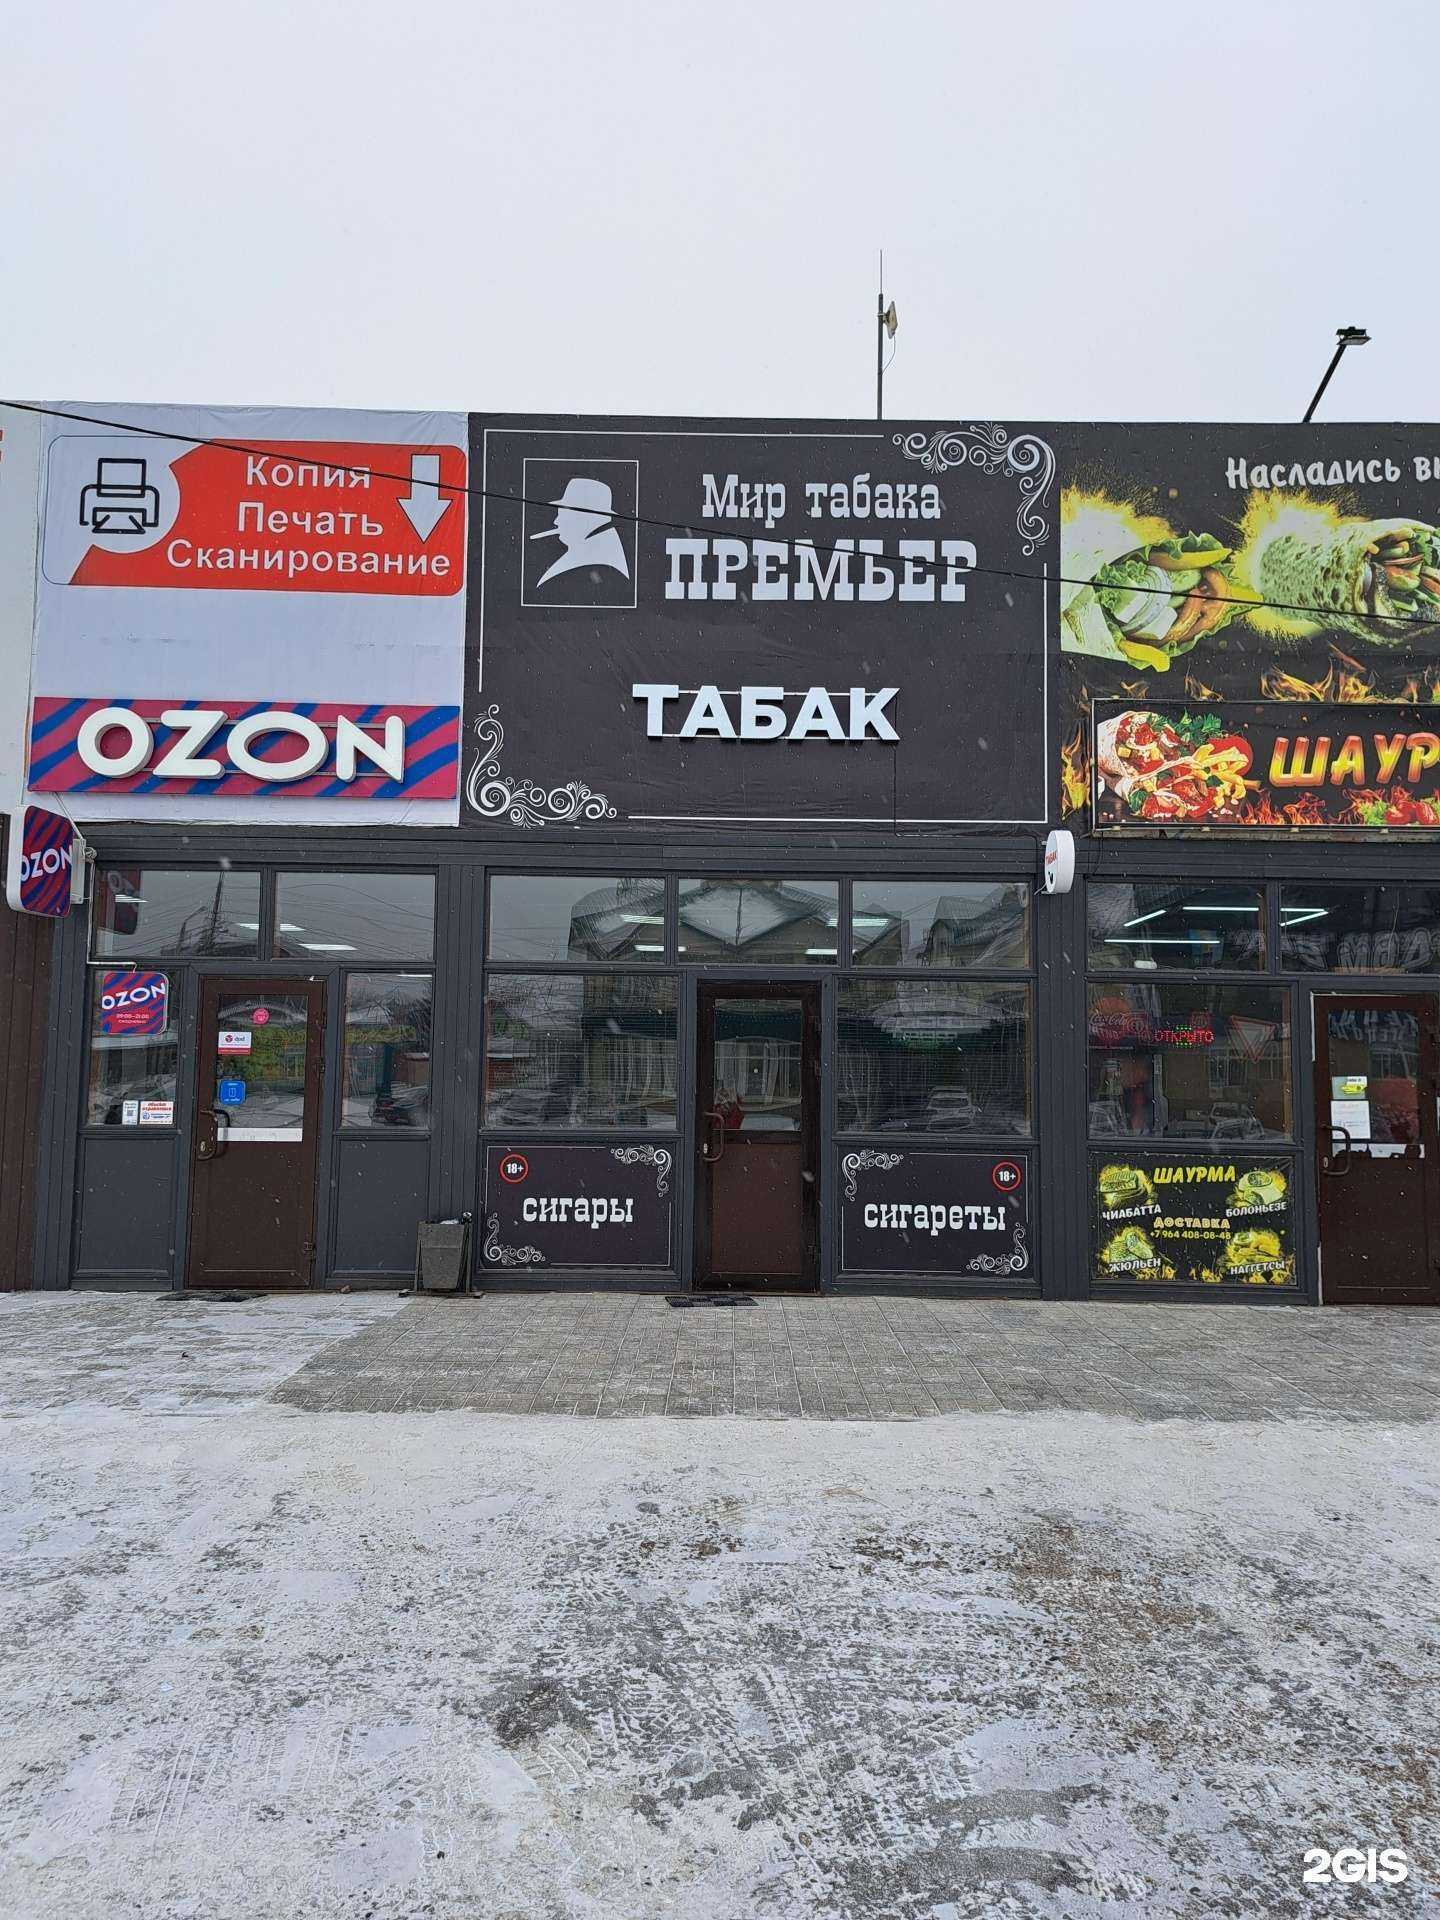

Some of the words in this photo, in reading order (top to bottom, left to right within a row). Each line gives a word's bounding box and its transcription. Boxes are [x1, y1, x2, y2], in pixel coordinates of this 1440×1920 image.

[246, 455, 371, 489] Копия
[1225, 457, 1401, 489] Насладись
[702, 473, 787, 529] Мир
[805, 473, 941, 520] табака
[237, 501, 384, 537] Печать
[166, 538, 451, 578] Сканирование
[664, 538, 978, 602] ПРЕМЬЕР
[632, 683, 900, 742] ТАБАК
[77, 707, 405, 783] OZON
[101, 982, 166, 1010] OZON
[506, 1162, 524, 1174] 18+
[999, 1170, 1016, 1182] 18+
[1153, 1165, 1236, 1184] ШАУРМА
[522, 1197, 634, 1230] сигары
[864, 1203, 1006, 1236] сигареты
[1102, 1204, 1162, 1221] ЧИАБАТТА
[1153, 1216, 1231, 1229] ДОСТАВКА
[1226, 1201, 1287, 1218] БОЛОНЬЕЗЕ
[1109, 1257, 1161, 1273] ЖЮЛЬЕН
[1230, 1260, 1285, 1275] НАГГЕТСЫ
